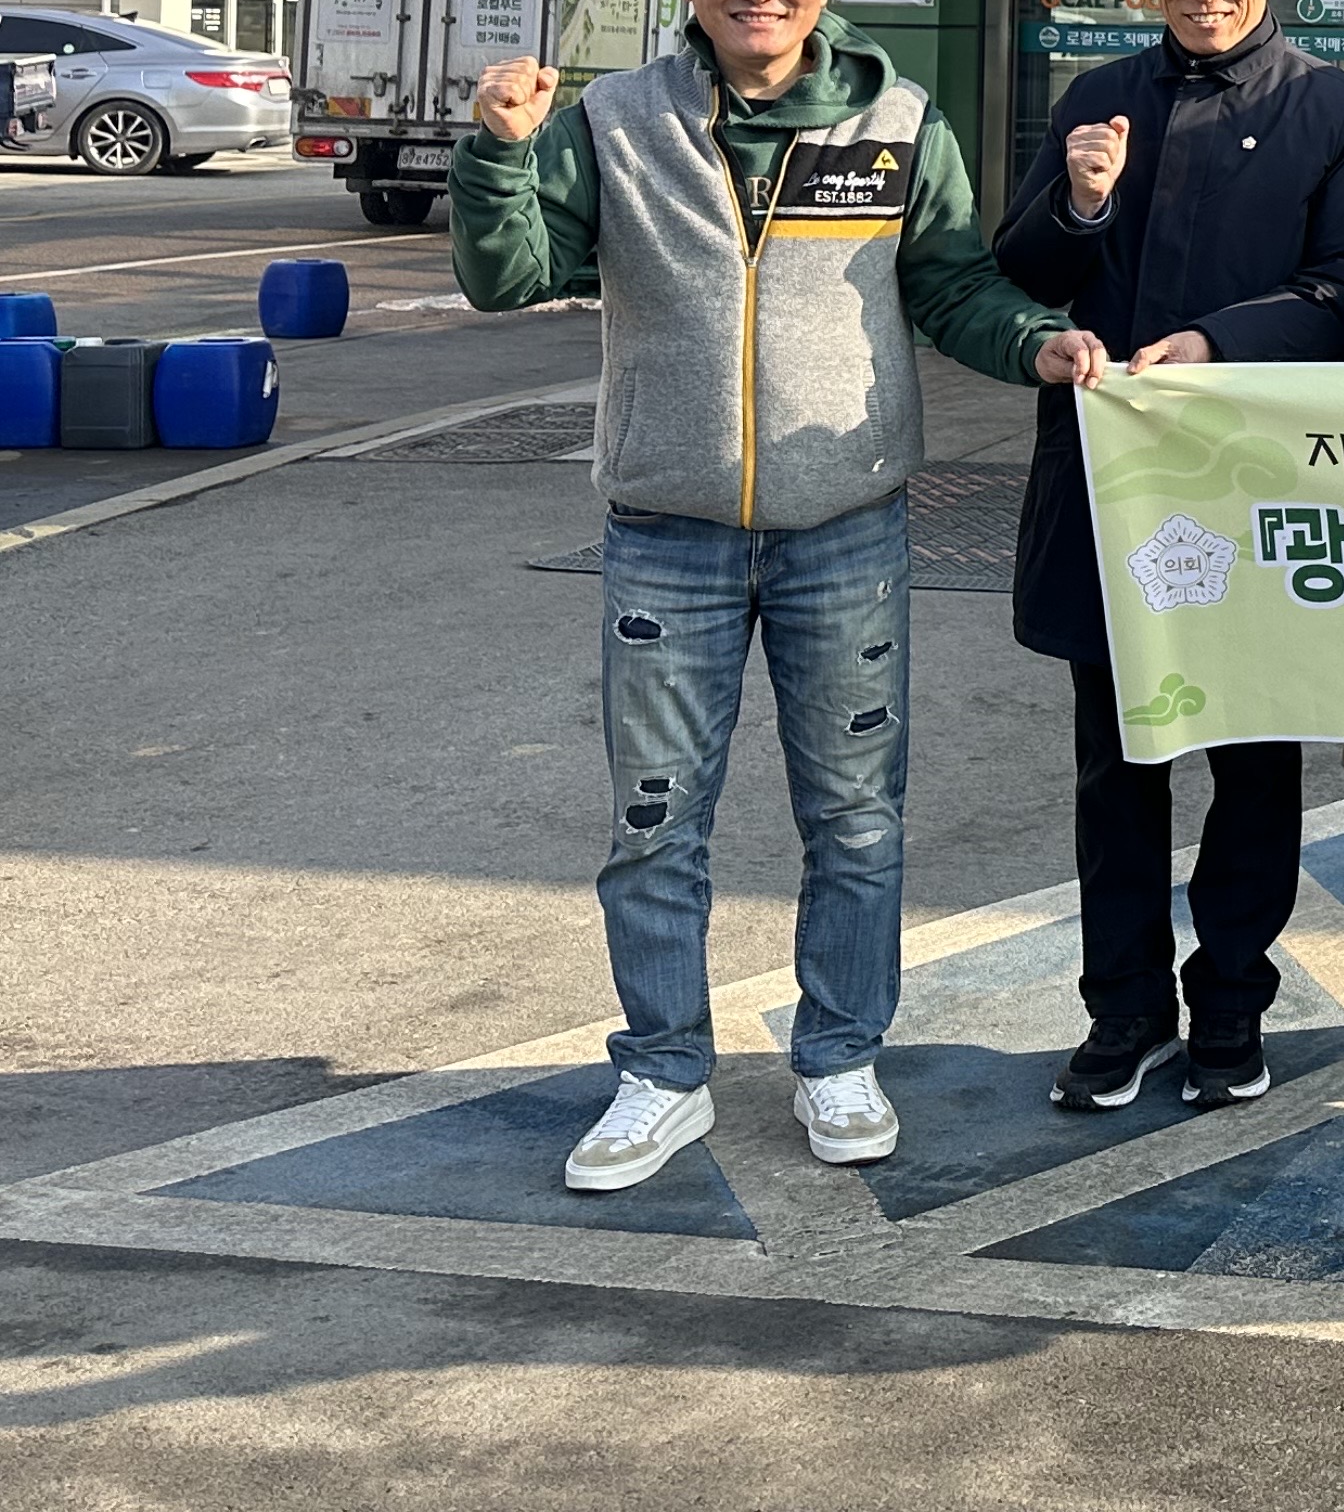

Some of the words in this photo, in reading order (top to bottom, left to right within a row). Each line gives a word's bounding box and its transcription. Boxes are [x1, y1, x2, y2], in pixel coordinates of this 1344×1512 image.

[1065, 31, 1121, 47] 로컬푸드
[814, 190, 874, 204] EST.1882
[1164, 554, 1203, 576] 의회
